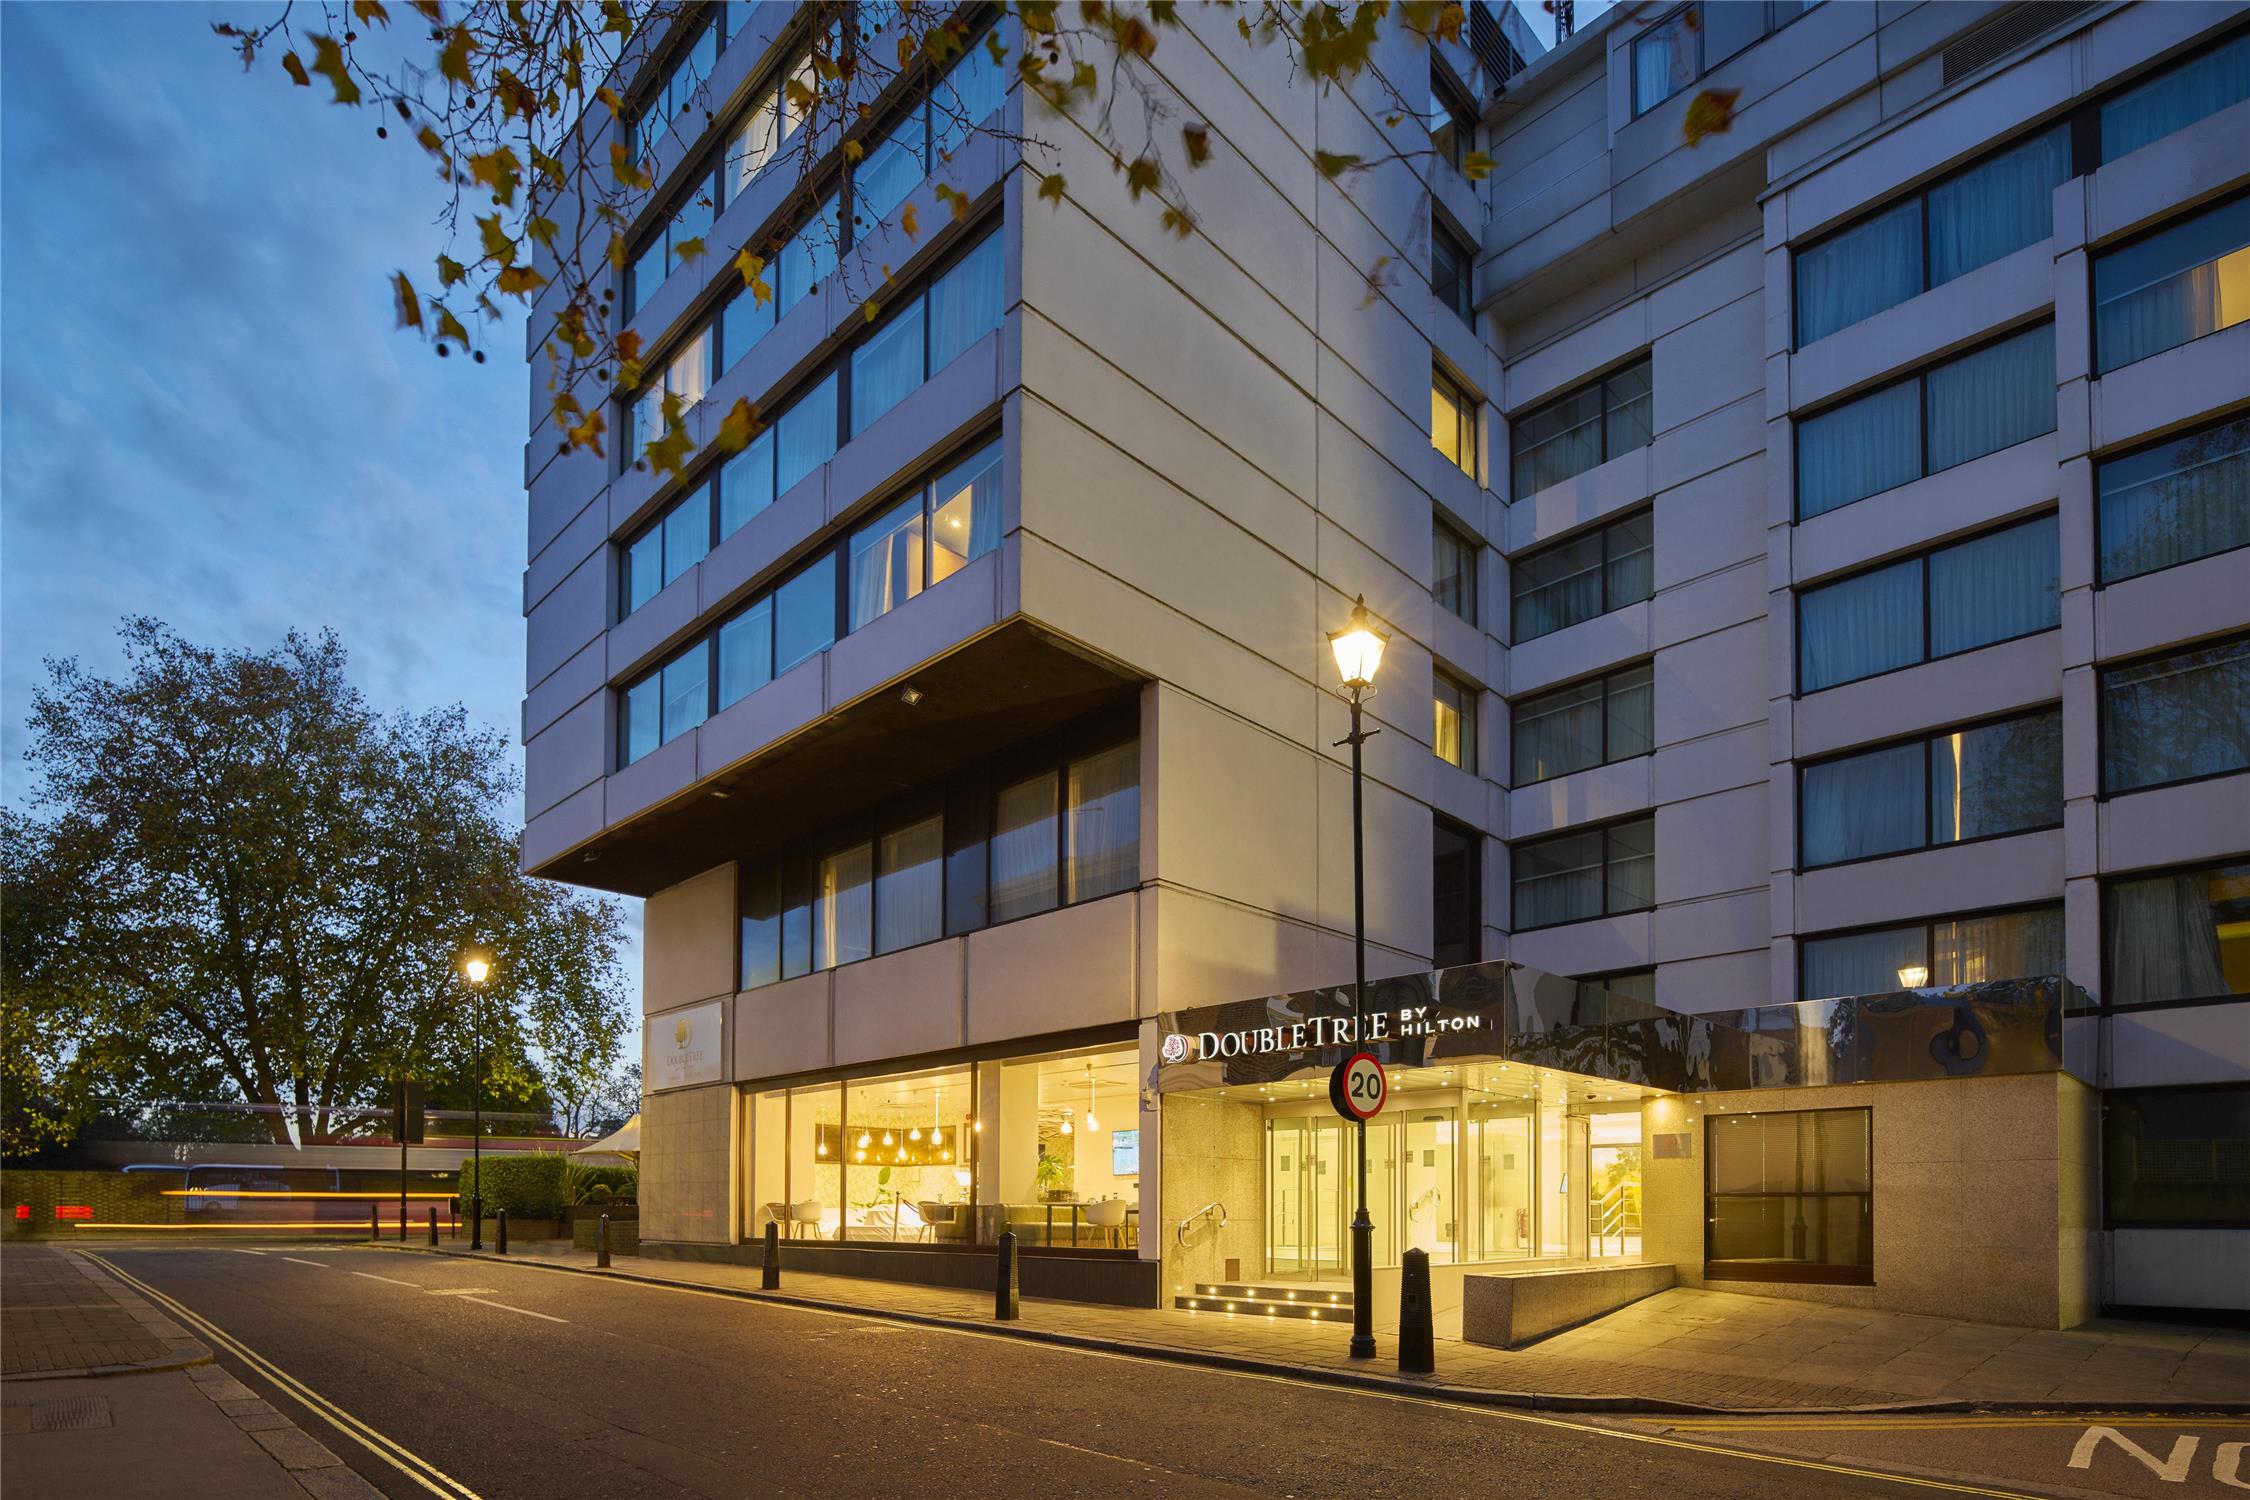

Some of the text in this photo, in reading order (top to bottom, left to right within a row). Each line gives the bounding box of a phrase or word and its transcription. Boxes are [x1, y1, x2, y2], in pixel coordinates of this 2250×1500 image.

[1401, 1006, 1427, 1021] BY
[1401, 1015, 1479, 1036] HILTON
[1198, 1012, 1390, 1060] DOUBLETREE
[1351, 1072, 1381, 1100] 20
